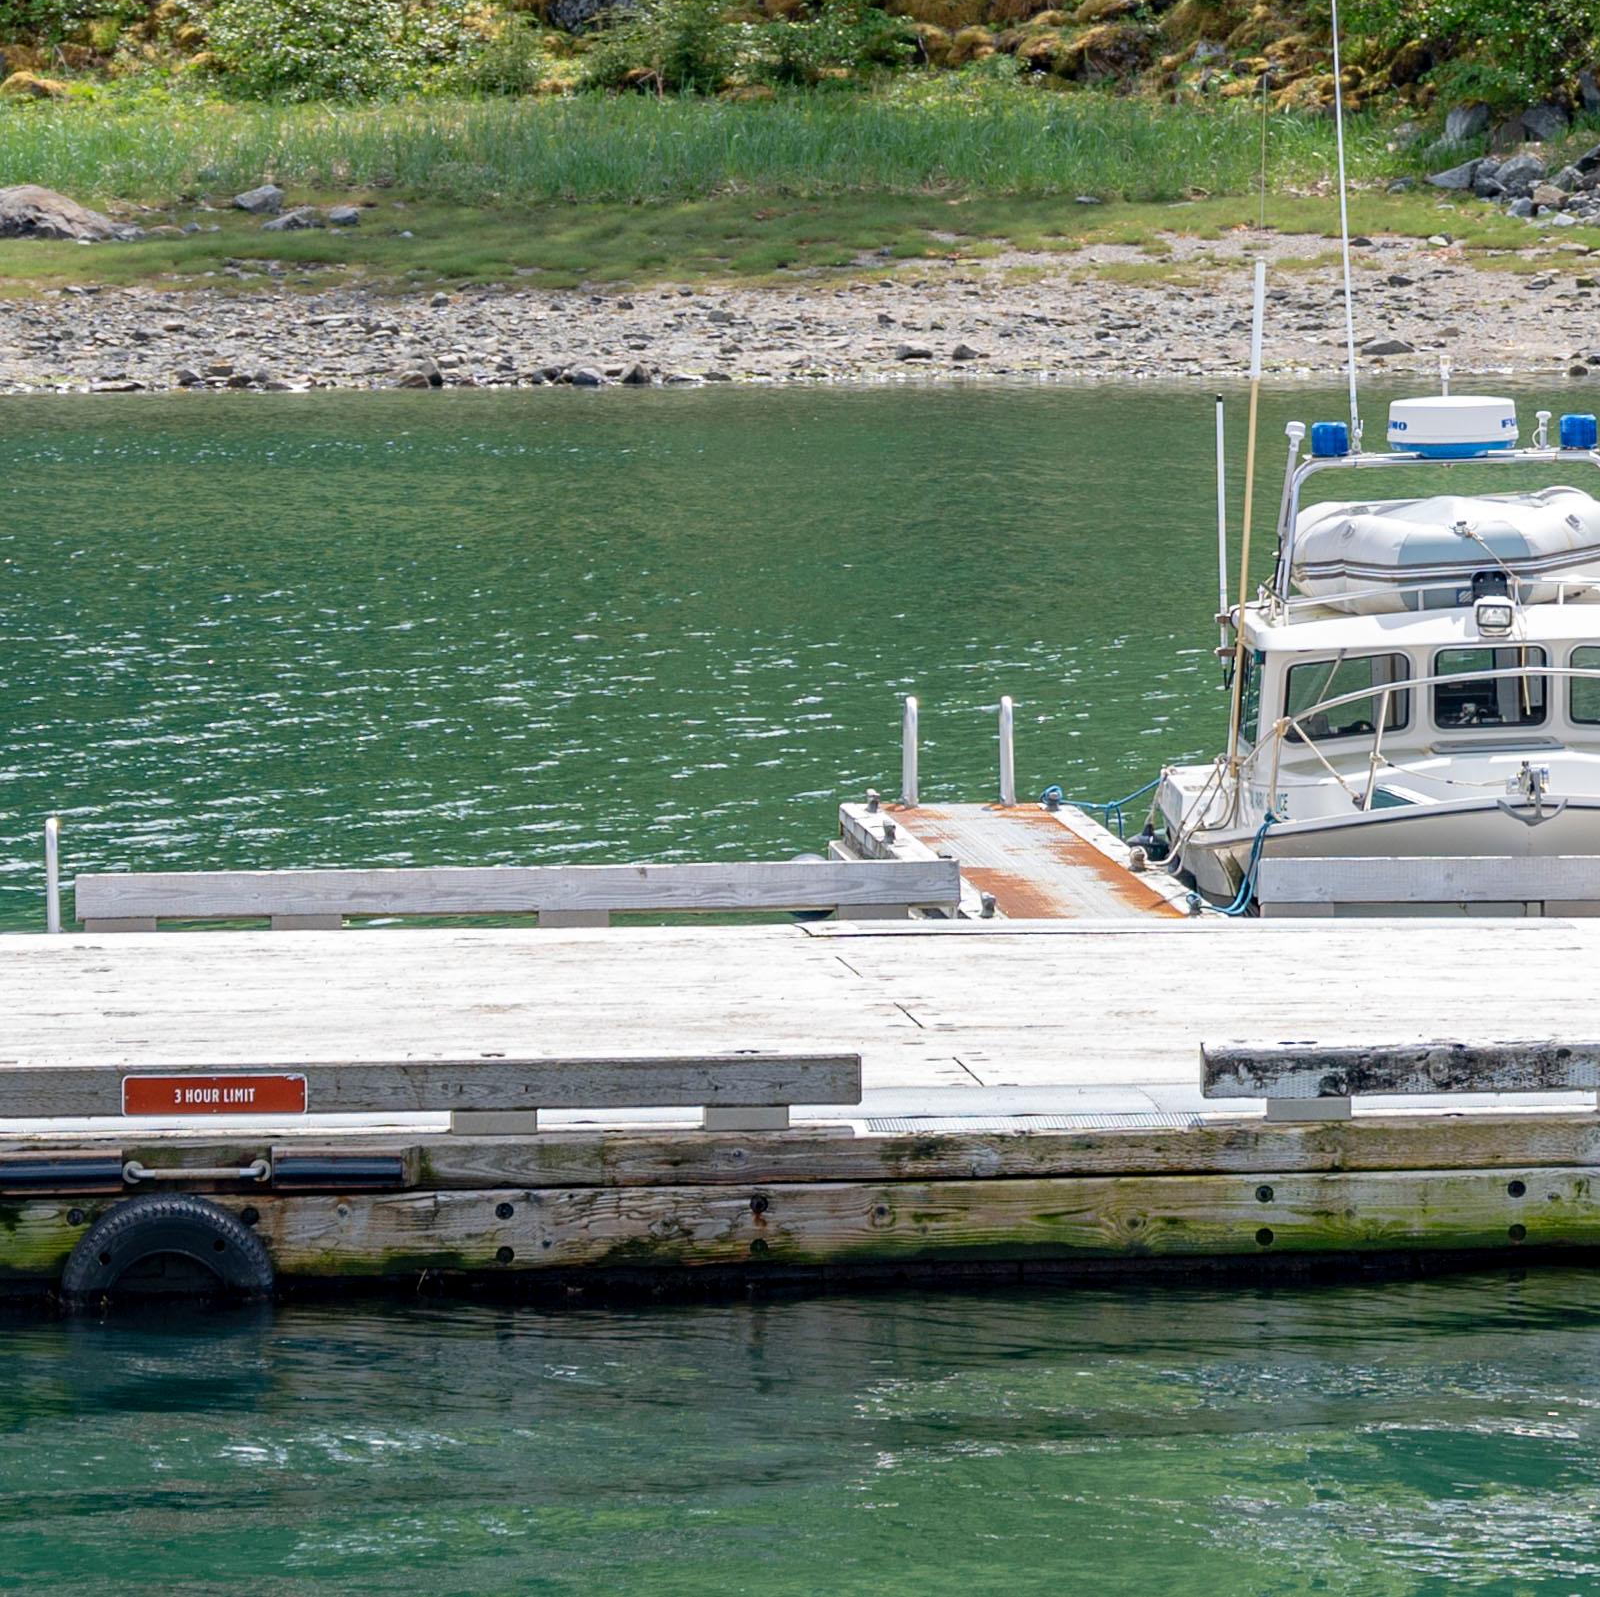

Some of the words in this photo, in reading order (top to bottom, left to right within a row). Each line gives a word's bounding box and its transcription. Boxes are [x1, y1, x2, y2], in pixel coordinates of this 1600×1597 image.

[174, 1089, 181, 1104] 3
[185, 1088, 220, 1103] HOUR
[223, 1087, 255, 1103] LIMIT
